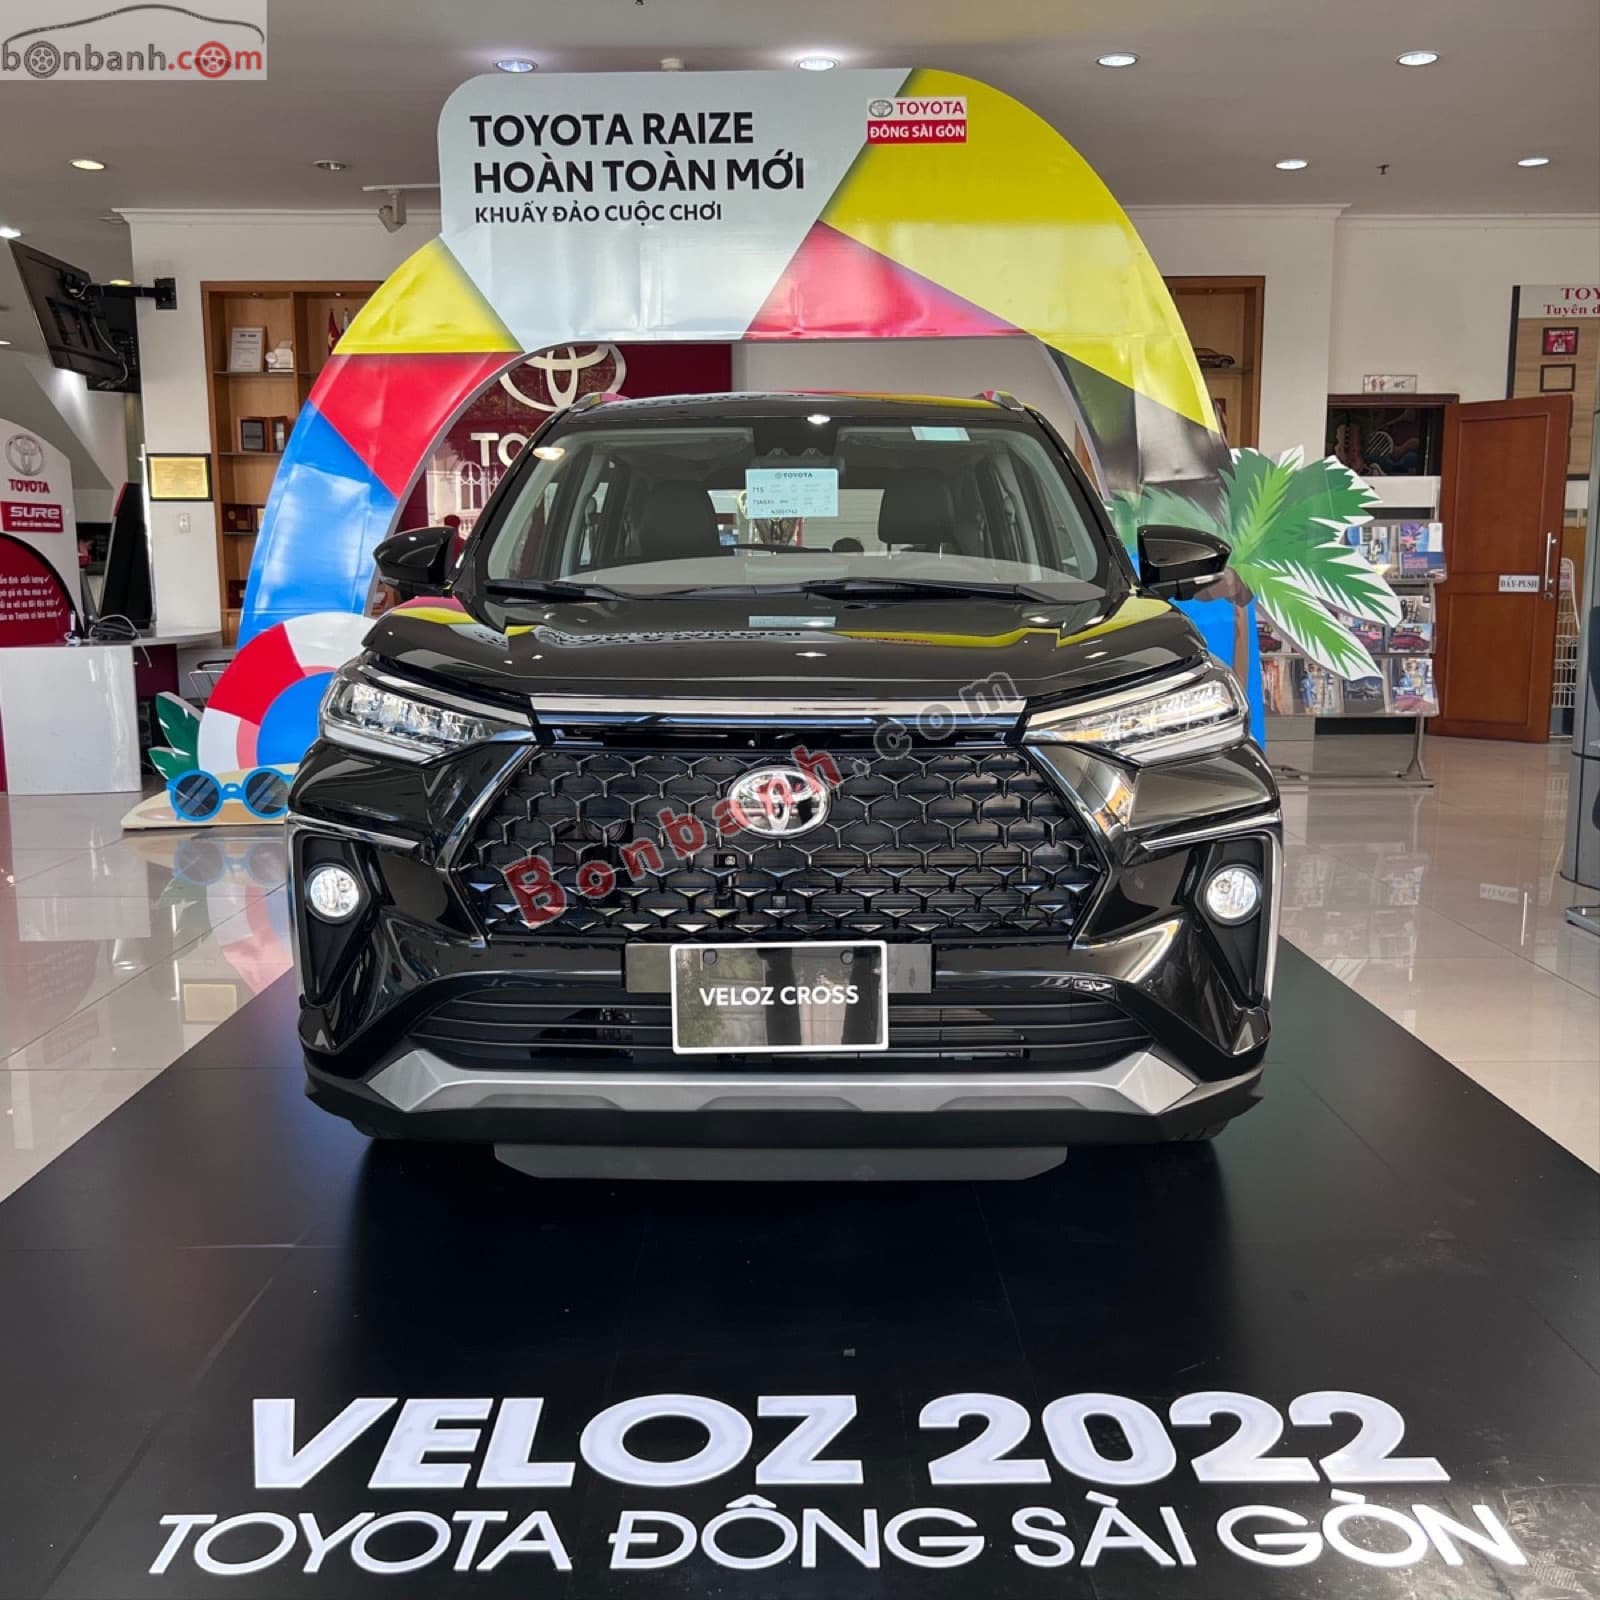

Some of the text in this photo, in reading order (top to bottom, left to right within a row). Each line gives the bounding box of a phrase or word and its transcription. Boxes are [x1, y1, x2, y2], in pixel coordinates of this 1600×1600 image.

[896, 101, 964, 115] TOYOTA
[469, 112, 754, 147] TOYOTA RAIZE
[869, 123, 965, 138] ĐÔNG SÀI GÒN
[474, 149, 805, 193] HOÀN TOÀN MỚI
[475, 200, 722, 226] KHUẤY ĐẢO CUỘC CHƠI
[8, 478, 51, 494] TOYOTA
[699, 985, 860, 1006] VELOZ CROSS
[252, 1390, 1452, 1489] VELOZ 2022
[148, 1488, 1529, 1576] TOYOTA ĐÔNG SÀI GÒN
